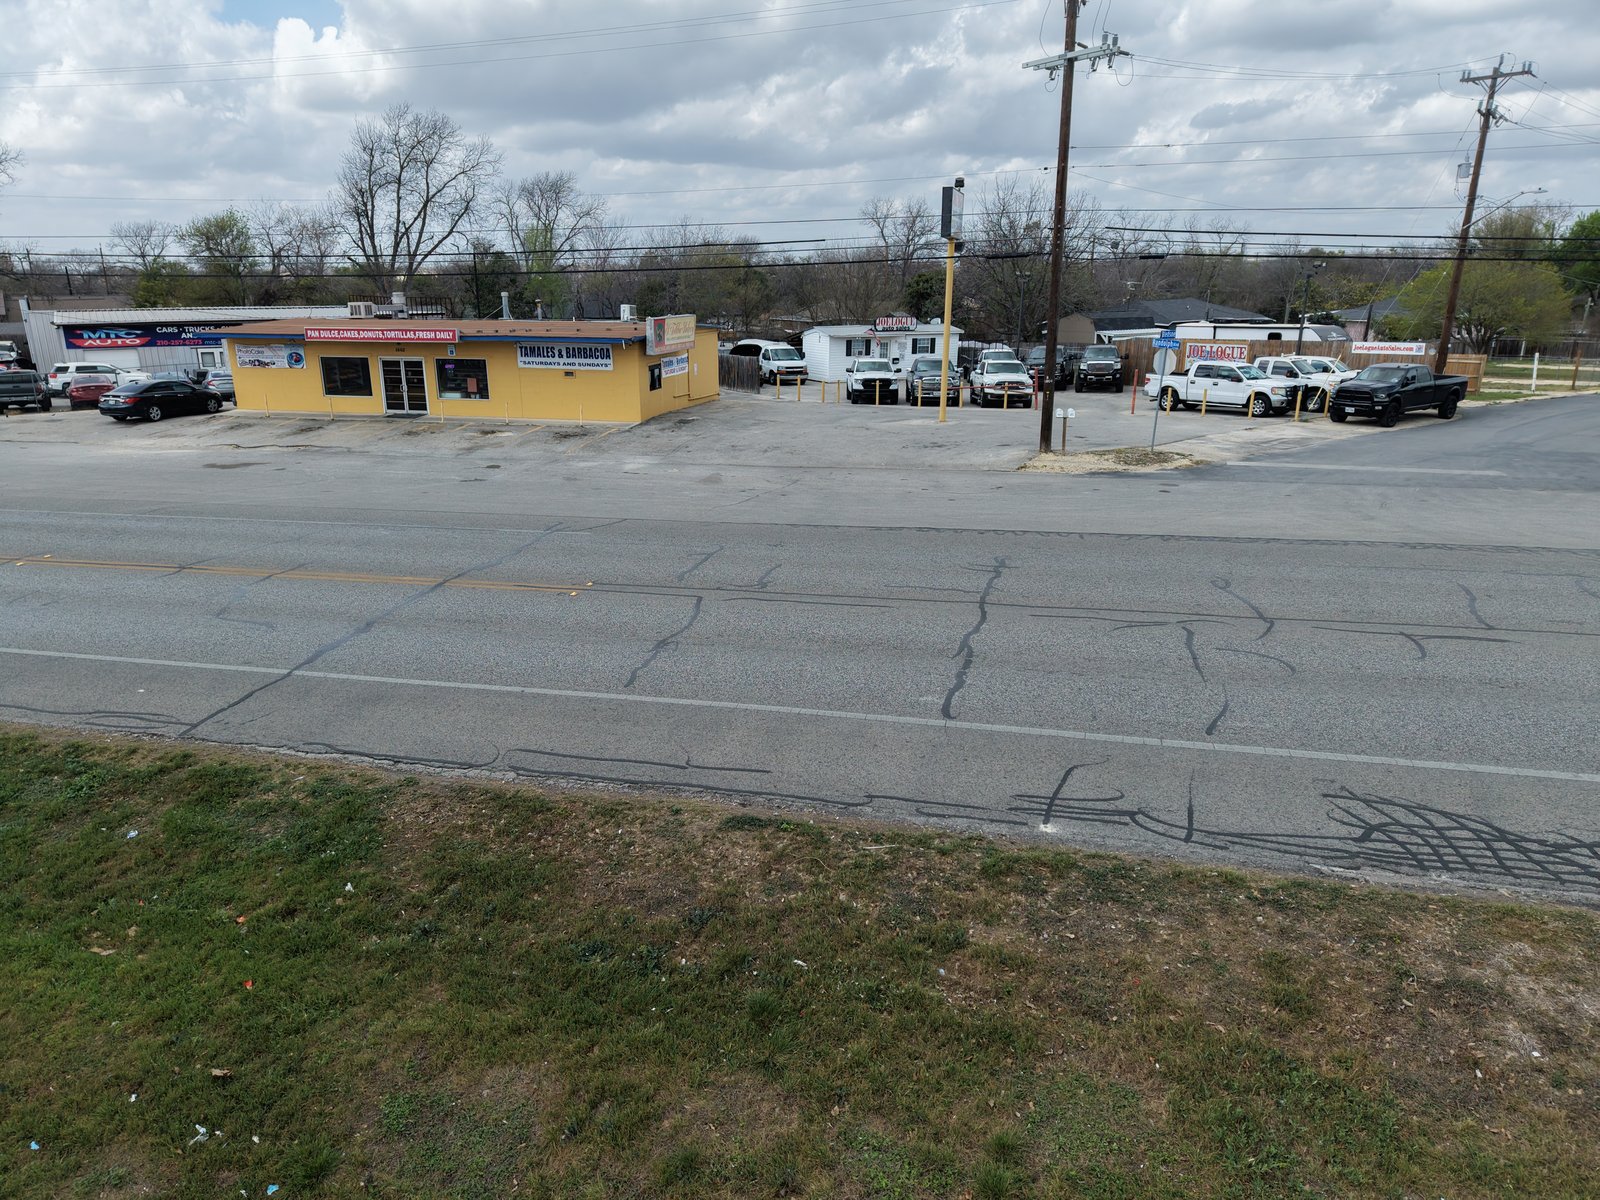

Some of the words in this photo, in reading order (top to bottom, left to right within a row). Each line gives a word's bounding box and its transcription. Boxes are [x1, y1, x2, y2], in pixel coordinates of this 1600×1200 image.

[82, 329, 137, 339] MTC
[184, 325, 215, 333] TRUCKS
[307, 330, 319, 338] PAN
[436, 331, 453, 339] DAILY
[519, 346, 556, 359] TAMALES
[557, 348, 564, 358] &
[565, 346, 611, 360] BARBACOA
[1187, 345, 1207, 358] JOE
[1209, 345, 1247, 360] LOGUE
